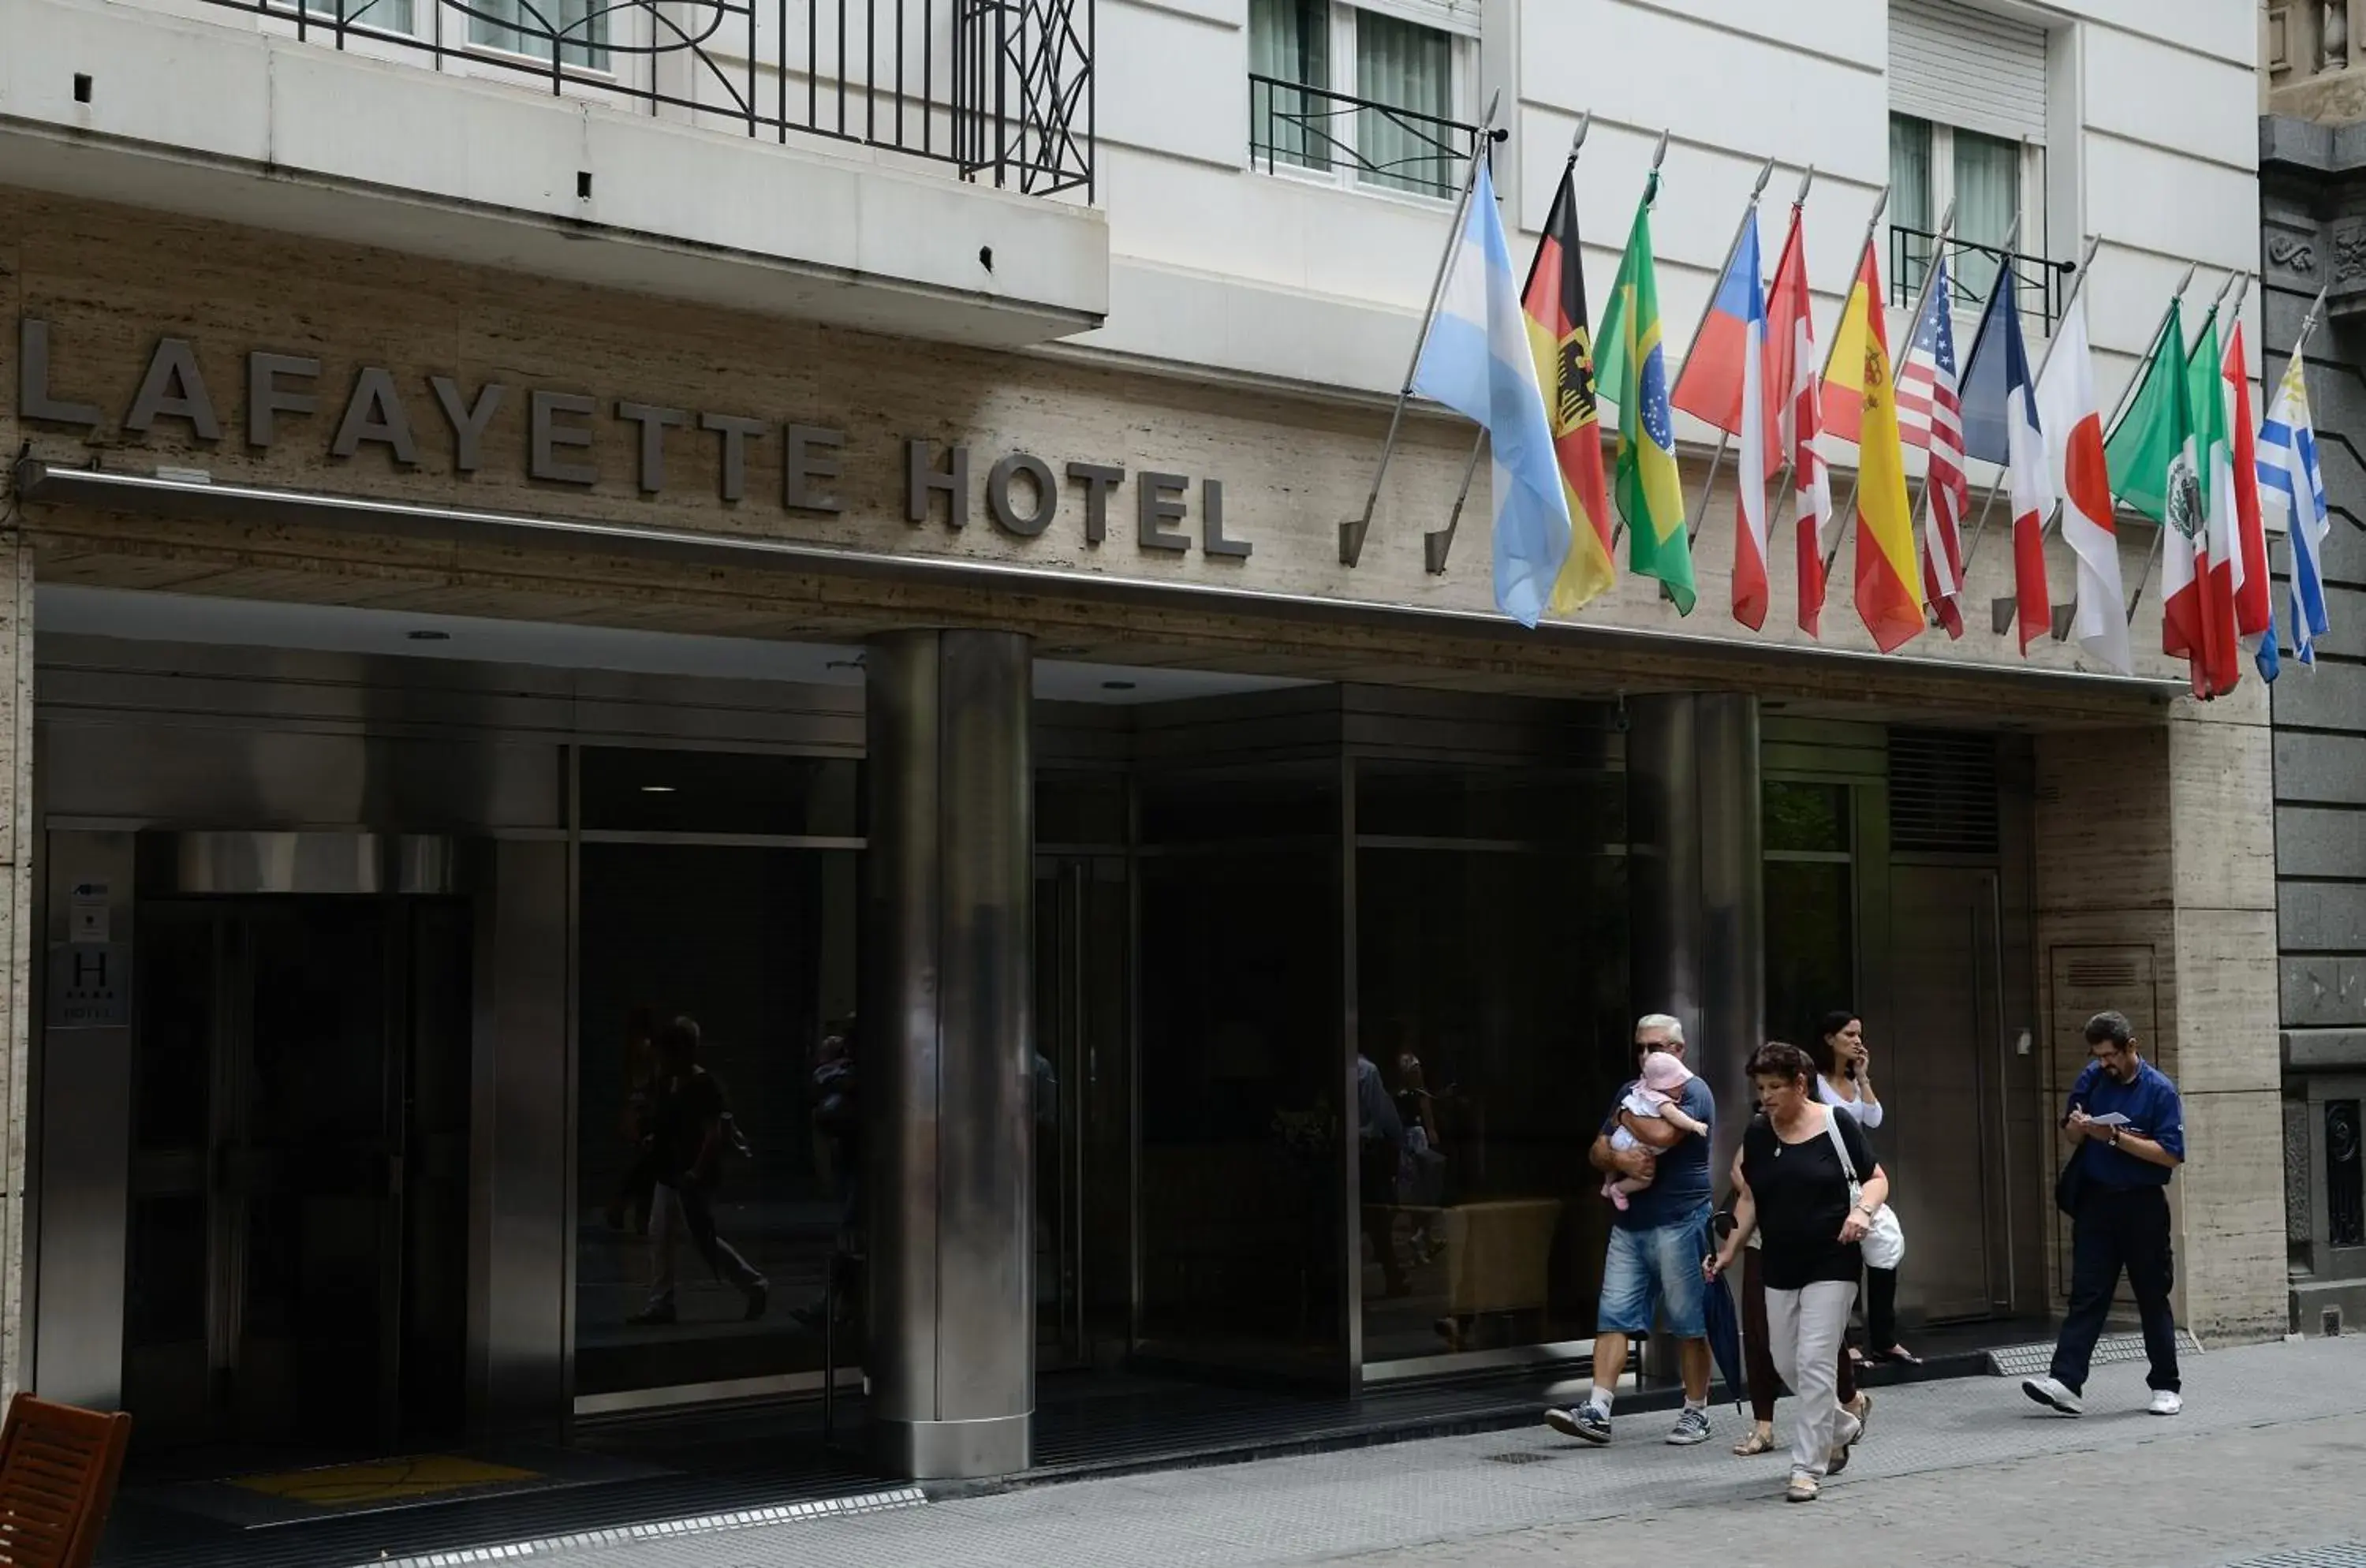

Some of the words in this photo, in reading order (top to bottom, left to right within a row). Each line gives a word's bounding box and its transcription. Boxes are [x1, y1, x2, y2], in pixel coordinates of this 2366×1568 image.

[20, 319, 845, 513] LAFAYETTE
[904, 438, 1253, 559] HOTEL
[74, 952, 106, 987] H
